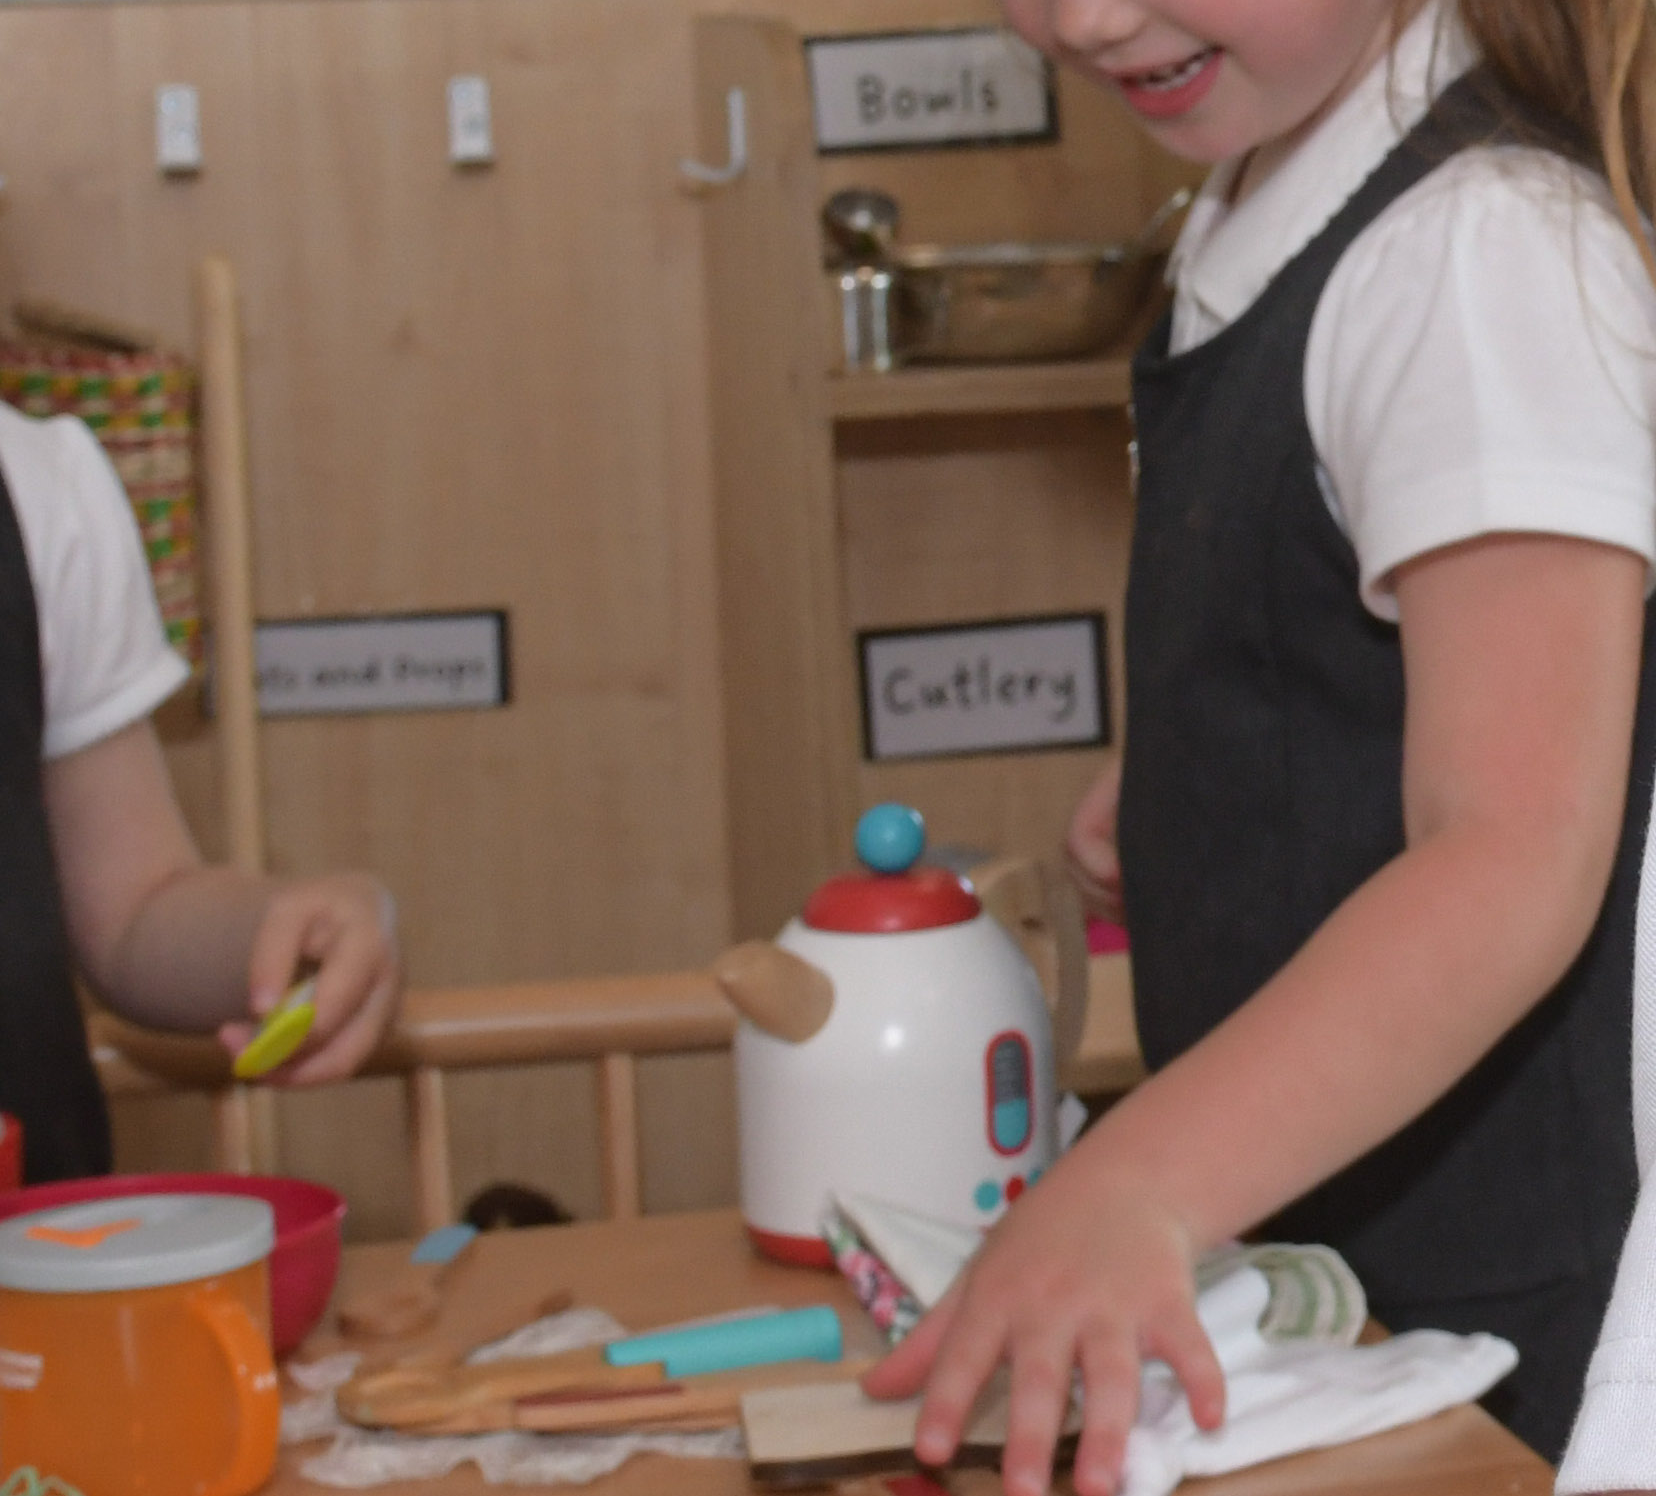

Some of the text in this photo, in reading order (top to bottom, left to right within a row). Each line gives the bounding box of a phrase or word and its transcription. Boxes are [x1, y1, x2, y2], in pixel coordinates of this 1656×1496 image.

[855, 66, 1001, 125] Bowls
[313, 654, 383, 688] and
[882, 652, 1079, 724] Cutlery
